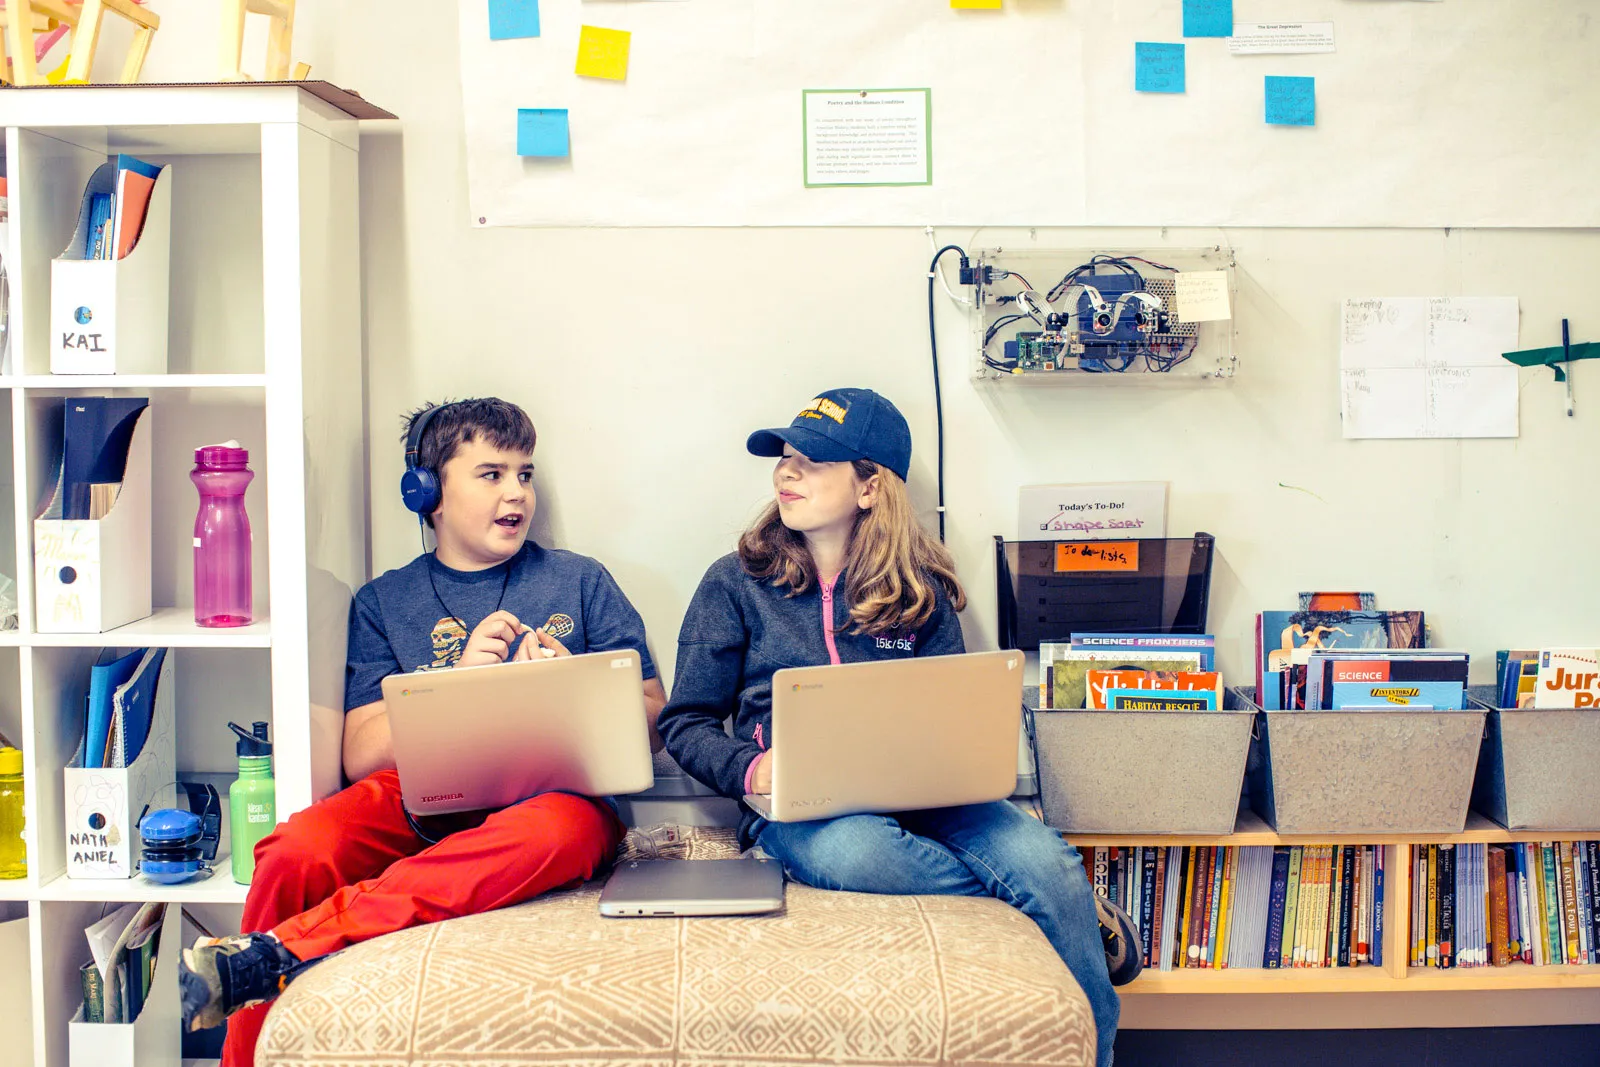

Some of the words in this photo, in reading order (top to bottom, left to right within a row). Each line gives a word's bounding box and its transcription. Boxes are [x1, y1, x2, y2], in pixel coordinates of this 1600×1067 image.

[62, 331, 107, 353] KAI
[1058, 503, 1093, 512] Today's
[1094, 502, 1125, 510] To-Do!
[1082, 637, 1135, 646] SCIENCE
[1137, 638, 1207, 646] FRONTIERS
[1338, 671, 1383, 680] SCIENCE
[1545, 667, 1600, 691] Jur
[1123, 699, 1163, 710] HABITAT
[1165, 702, 1201, 710] RESCUE
[420, 792, 465, 803] TOSHIBA
[70, 832, 108, 848] NATH
[73, 850, 118, 866] ANIEL
[1589, 843, 1597, 868] Opening
[1563, 866, 1575, 906] ARTEMIS
[1591, 868, 1599, 896] Pandora's
[1144, 870, 1154, 920] MIDNIGHT
[1196, 889, 1205, 908] Morrie
[1567, 908, 1577, 935] FOWL
[1143, 922, 1151, 954] MAGIC
